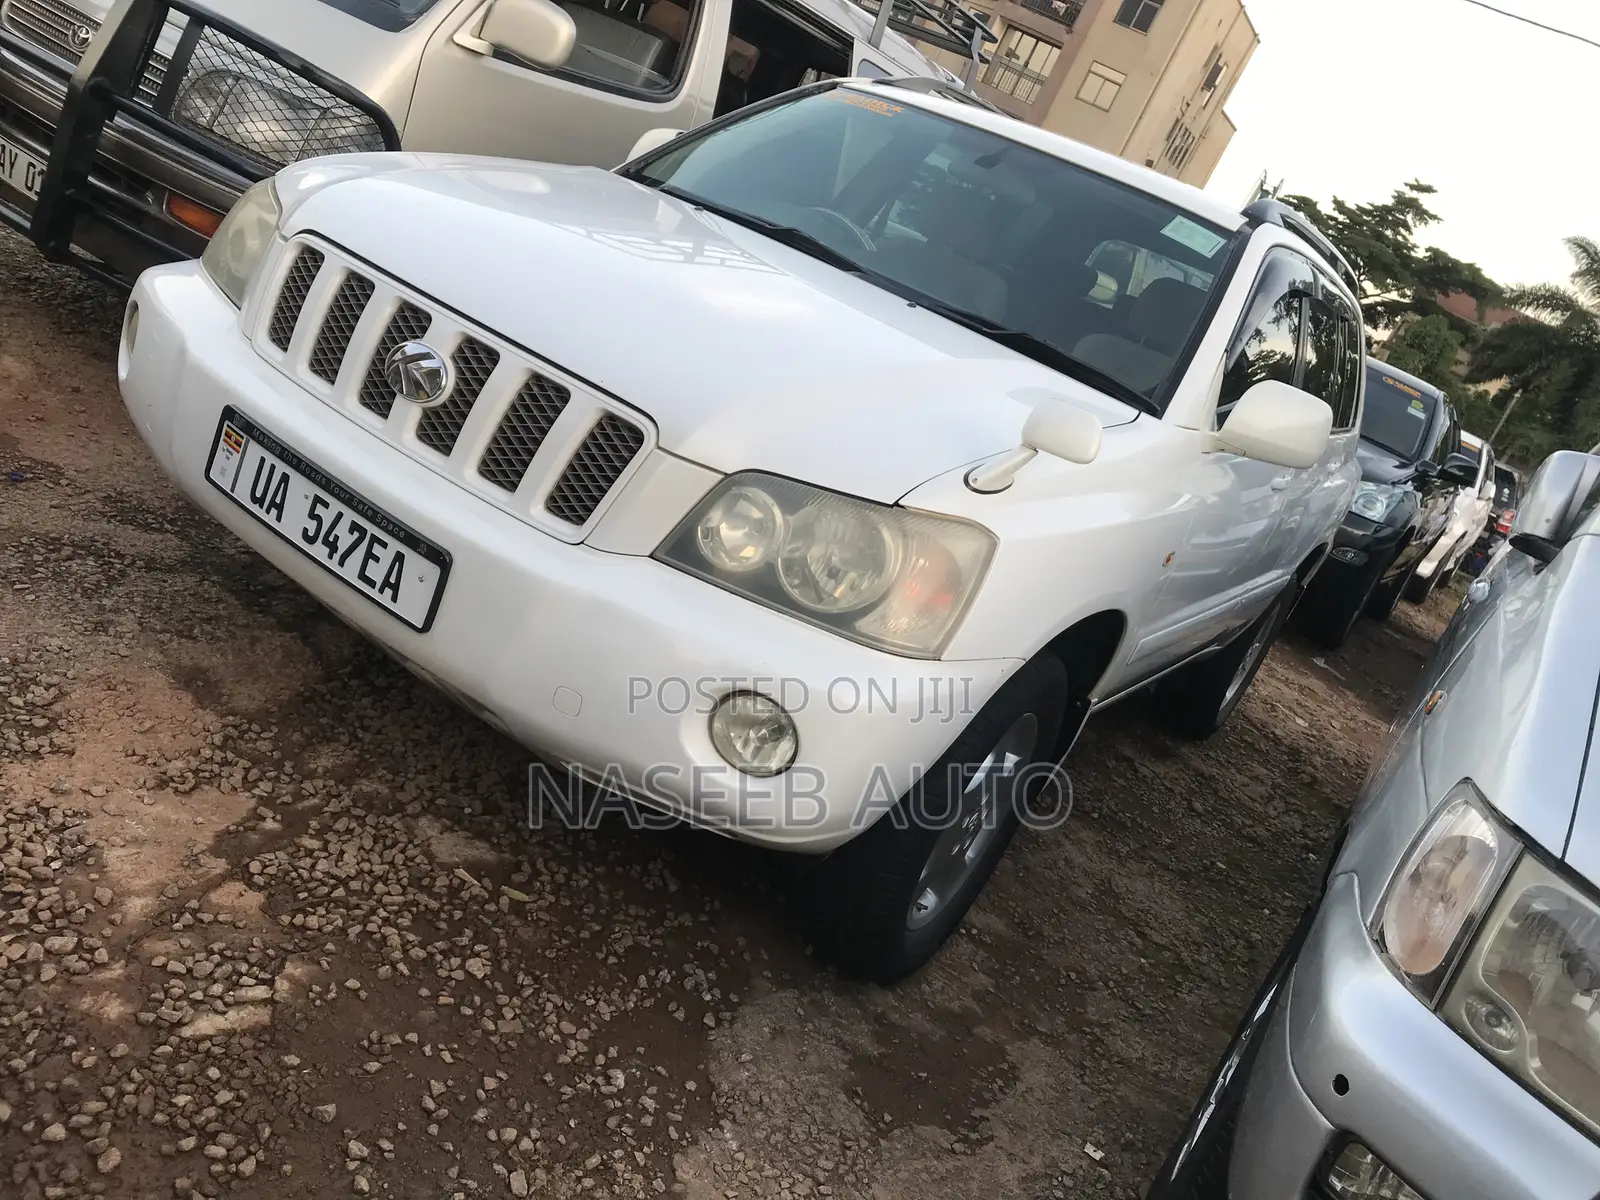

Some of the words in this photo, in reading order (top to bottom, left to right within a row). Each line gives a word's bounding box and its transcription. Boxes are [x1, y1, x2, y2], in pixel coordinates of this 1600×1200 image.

[249, 455, 290, 523] UA
[301, 493, 406, 604] 547EA
[251, 427, 280, 454] Making
[283, 448, 298, 465] the
[300, 461, 327, 486] Roads
[329, 481, 350, 501] Your
[352, 498, 373, 518] Safe
[375, 510, 406, 538] Space
